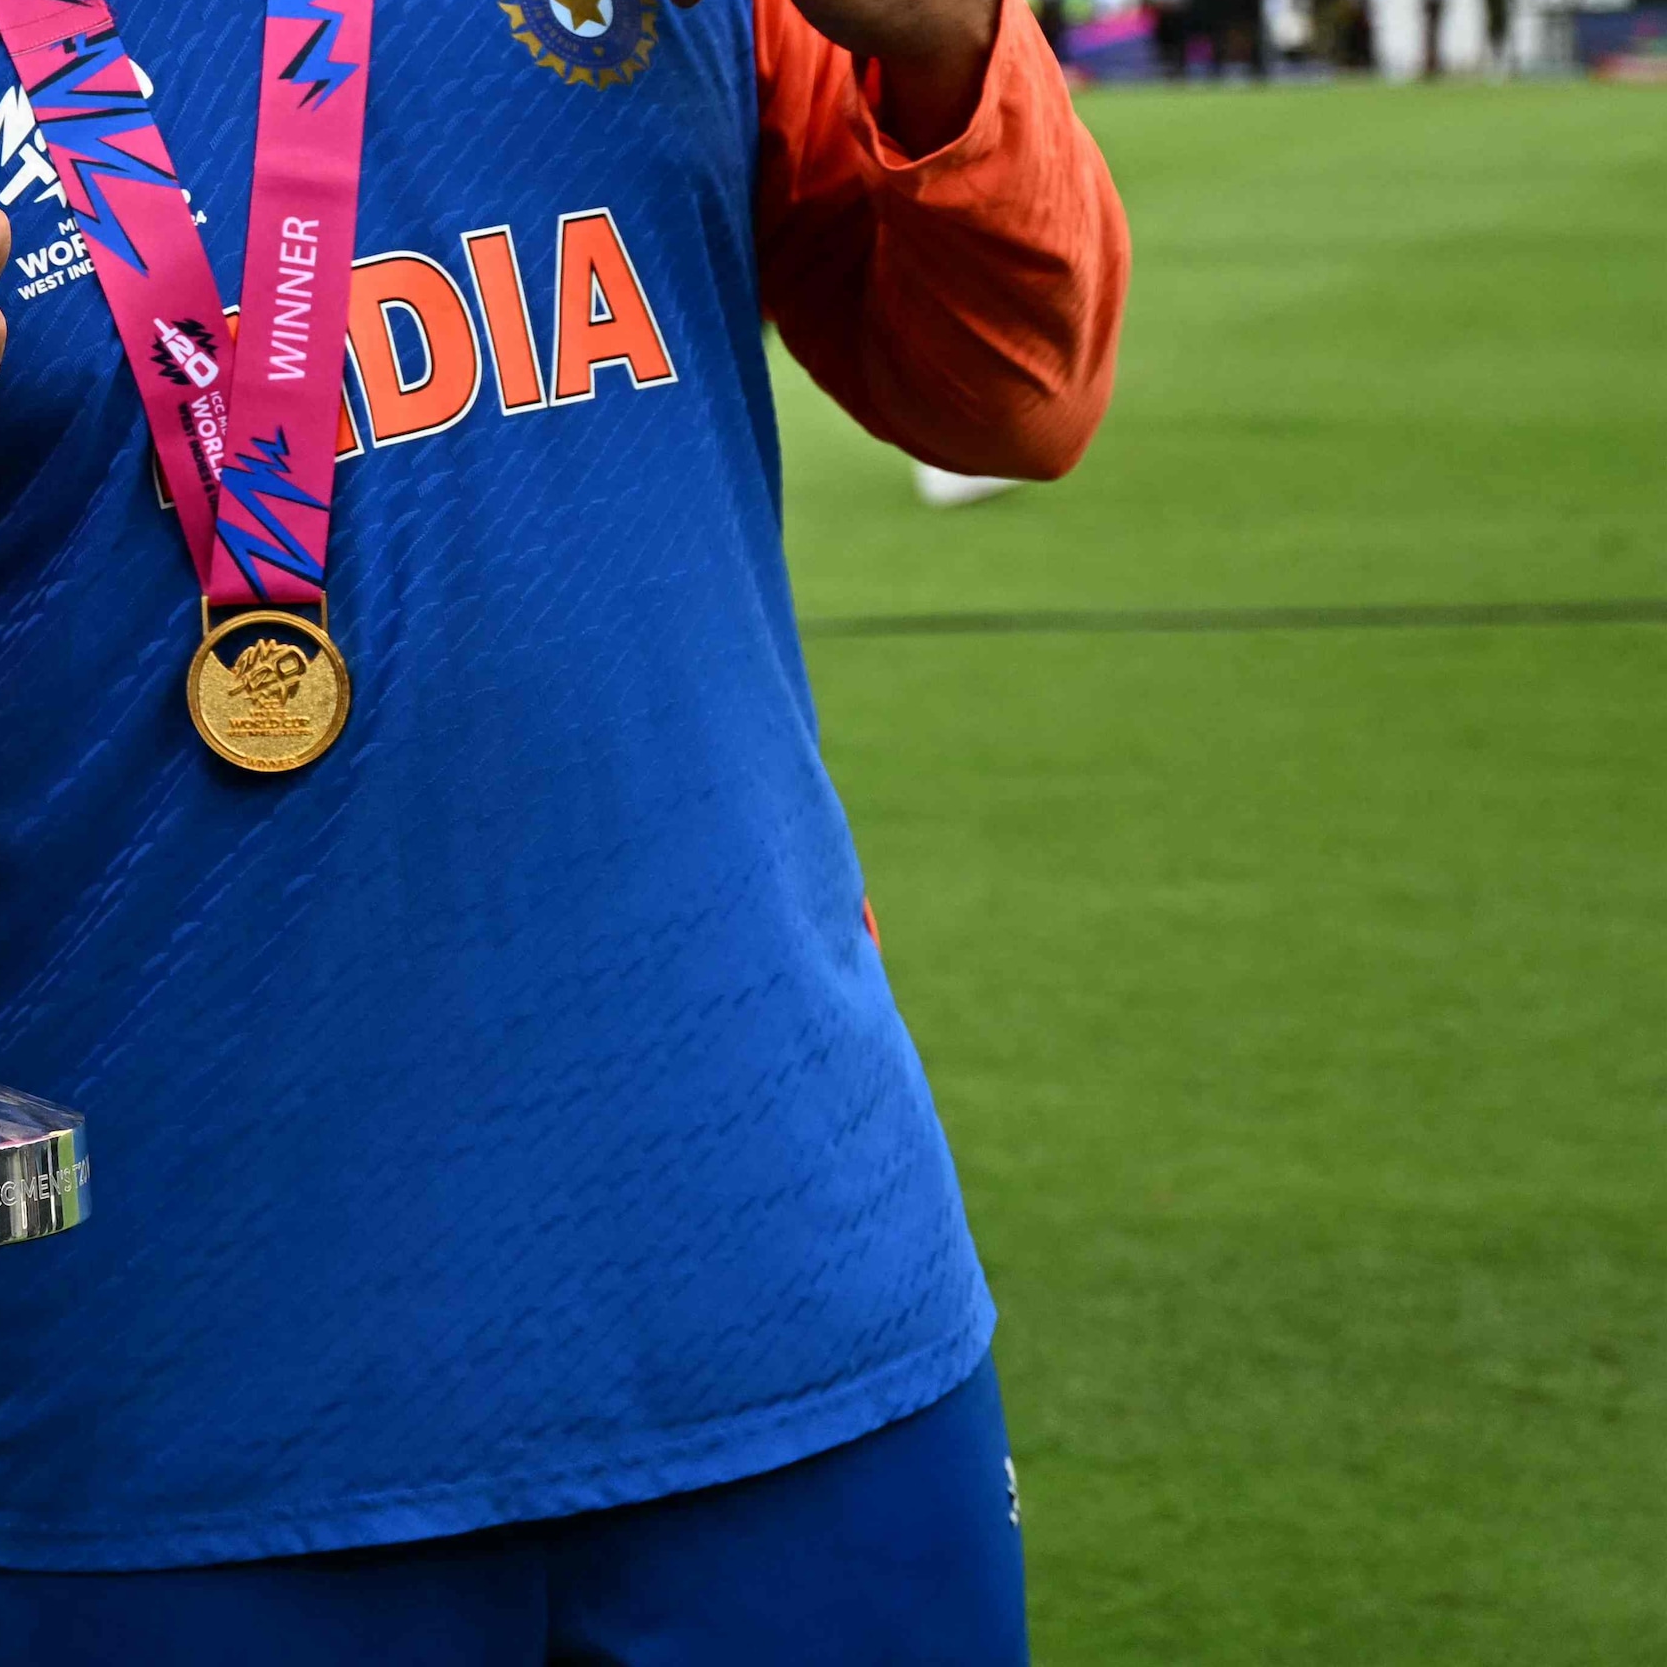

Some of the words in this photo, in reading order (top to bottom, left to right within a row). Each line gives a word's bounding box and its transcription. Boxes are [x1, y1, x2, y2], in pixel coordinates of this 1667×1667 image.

[18, 271, 65, 301] WEST
[267, 216, 320, 382] WINNER
[210, 390, 225, 415] ICC
[20, 1168, 72, 1202] MEN'S
